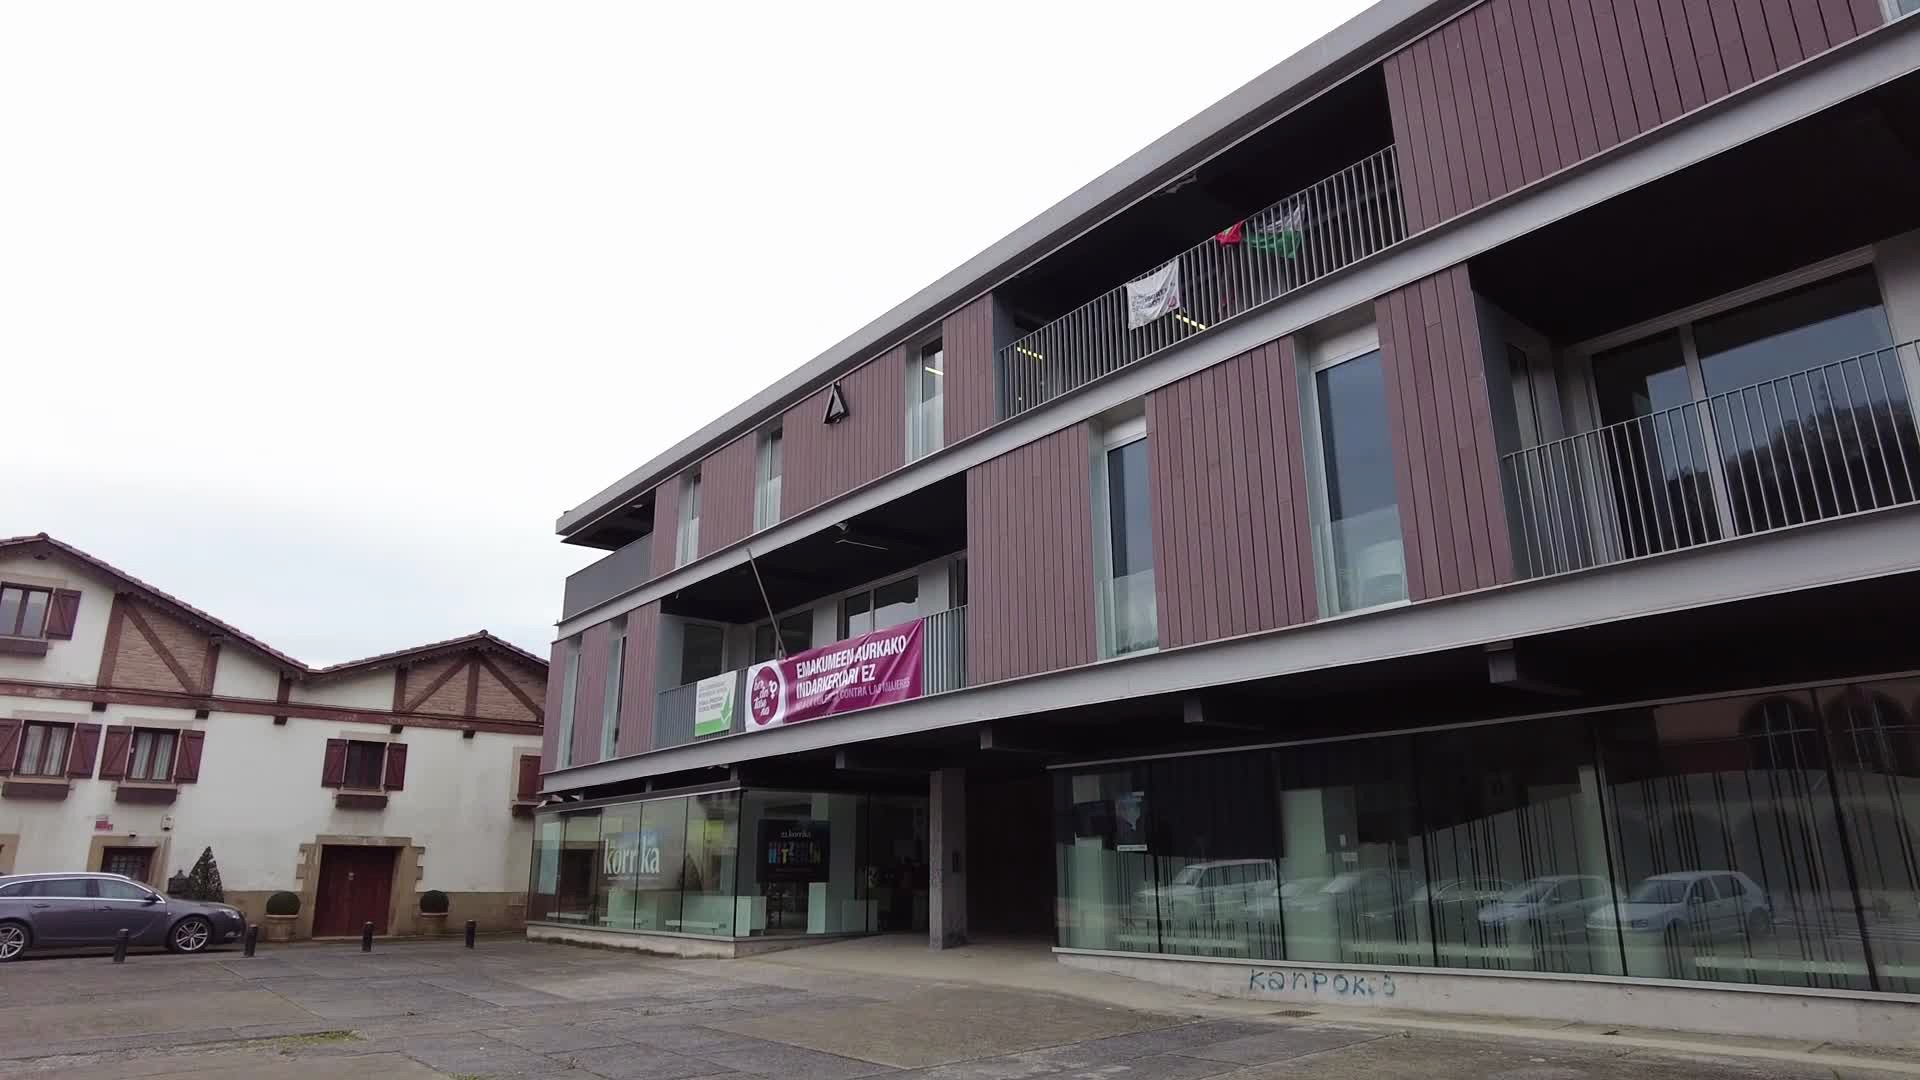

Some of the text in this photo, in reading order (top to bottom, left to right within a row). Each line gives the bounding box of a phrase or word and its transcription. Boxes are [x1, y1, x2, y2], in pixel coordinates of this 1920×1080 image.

[796, 635, 907, 679] EMAKUMEEN AURKAKO
[862, 664, 876, 682] EZ
[840, 685, 868, 699] CONTRA
[603, 836, 660, 875] korrka
